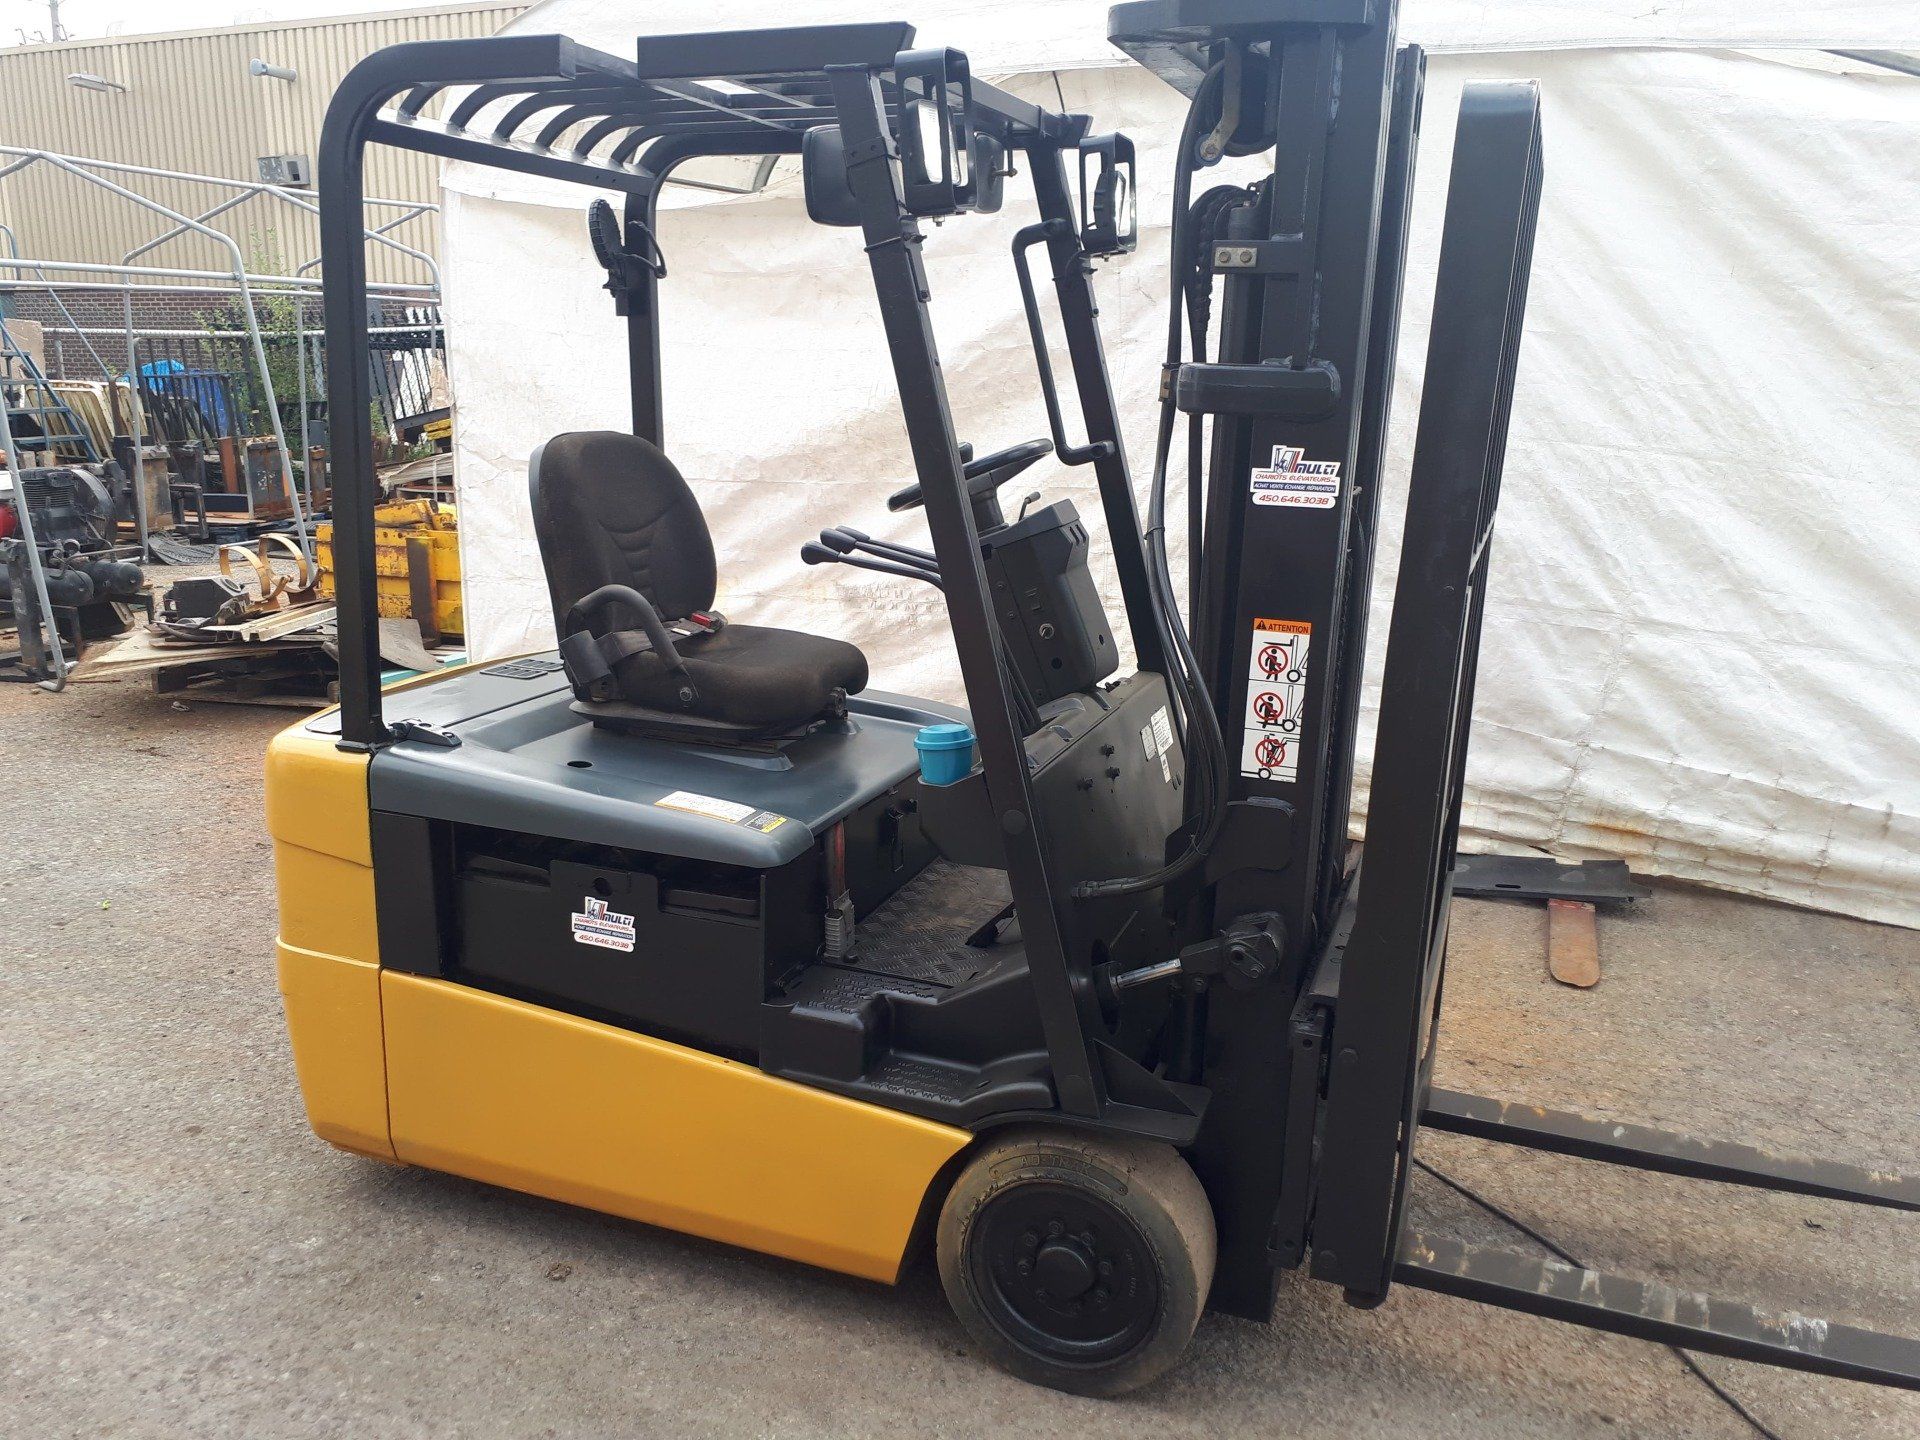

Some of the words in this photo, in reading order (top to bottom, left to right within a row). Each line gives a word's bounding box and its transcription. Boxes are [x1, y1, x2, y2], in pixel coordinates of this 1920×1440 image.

[1255, 473, 1287, 481] CHARIOTS
[1259, 494, 1329, 505] 450.646.3038
[1268, 623, 1309, 634] ATTENTION
[579, 934, 629, 948] 450.646.3038
